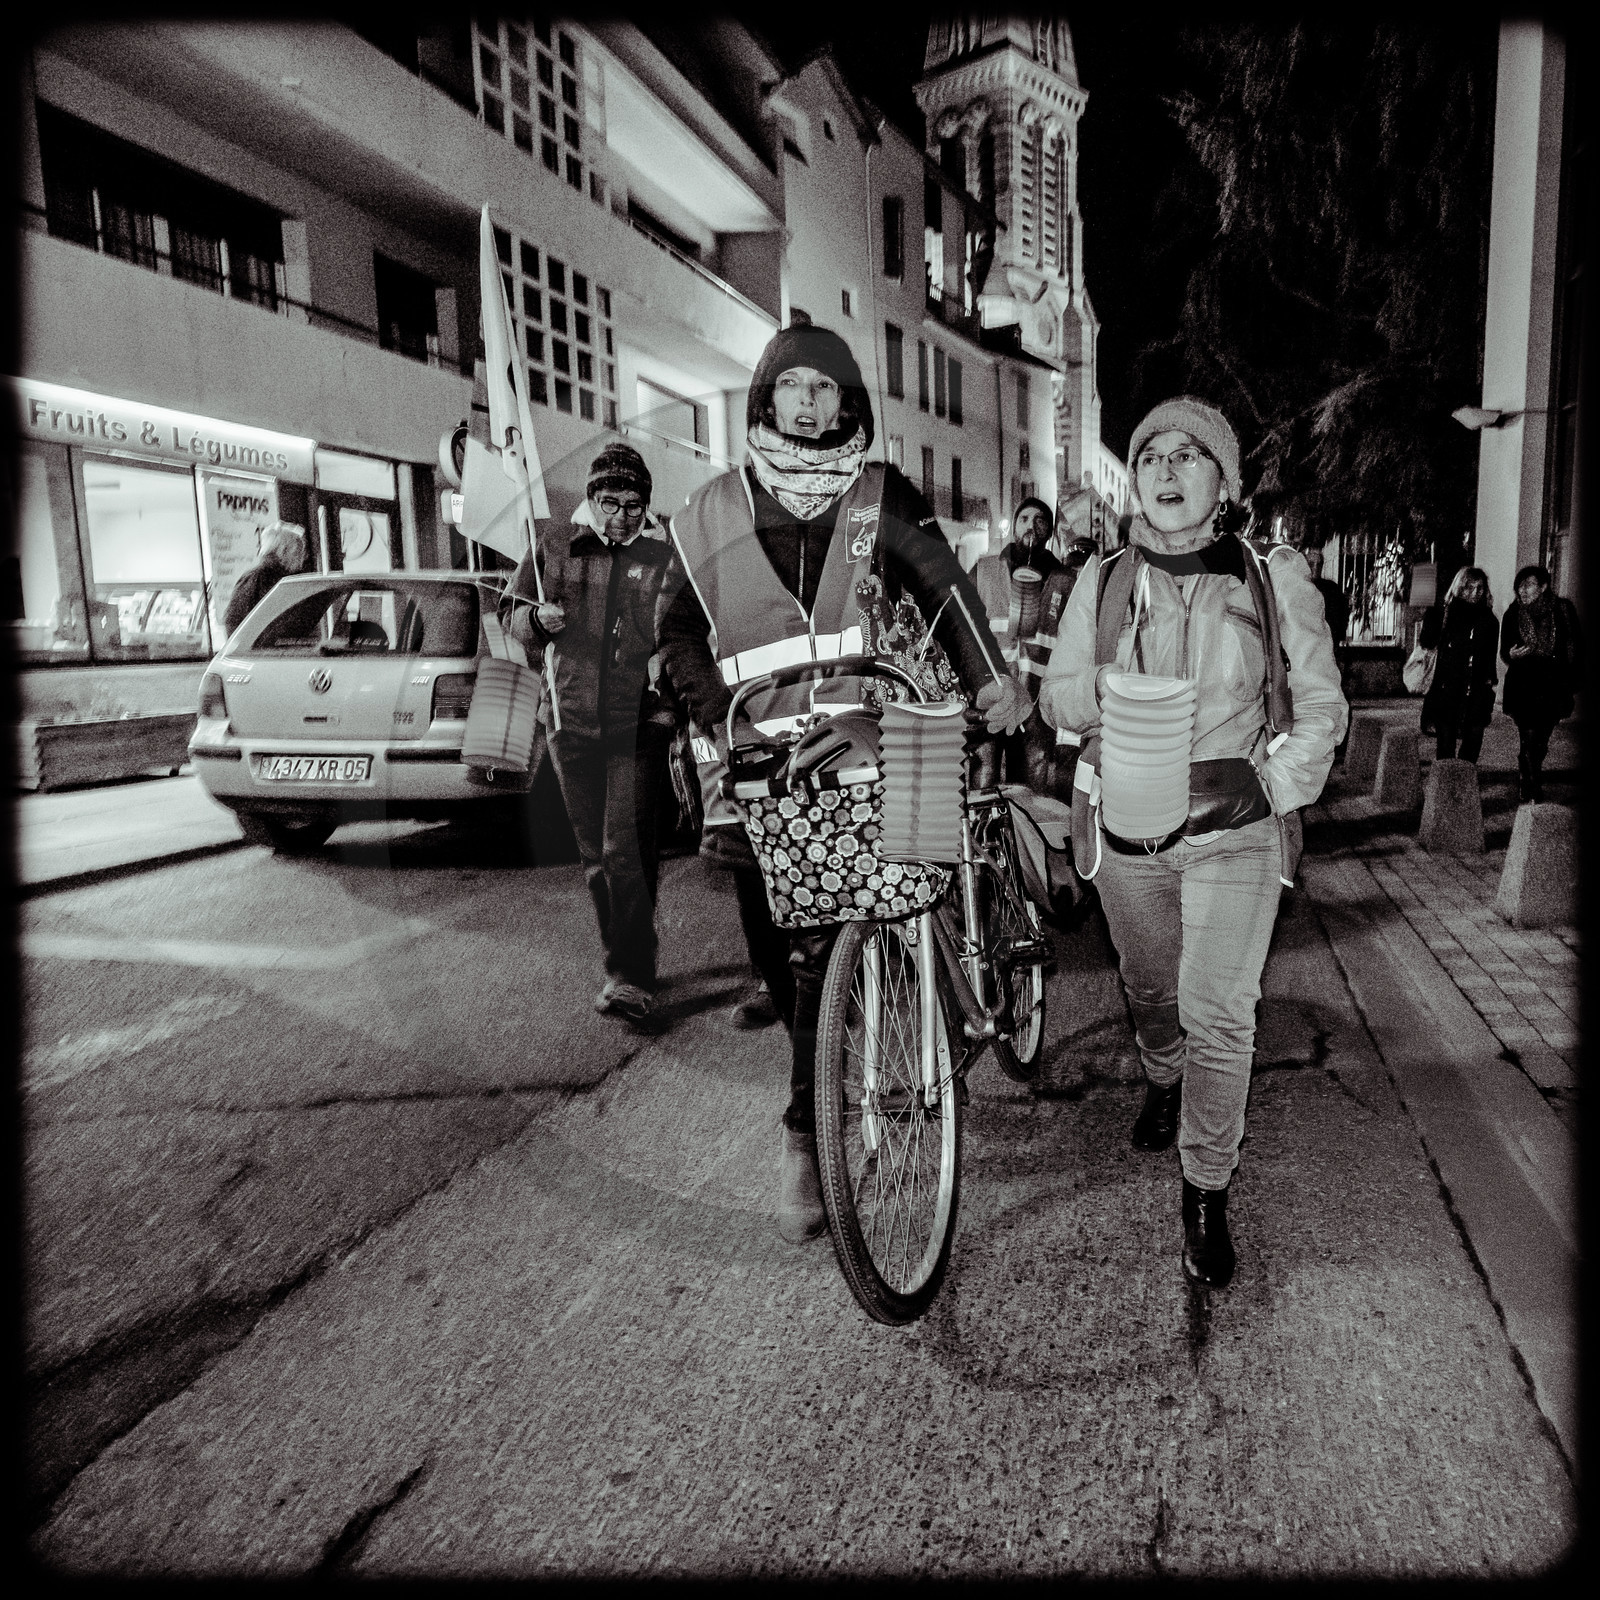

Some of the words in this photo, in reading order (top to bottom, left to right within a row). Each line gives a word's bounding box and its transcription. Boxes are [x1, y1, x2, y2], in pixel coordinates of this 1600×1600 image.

[27, 398, 127, 442] Fruits
[138, 420, 161, 448] &
[171, 427, 289, 471] Légumes
[342, 759, 368, 780] 05
